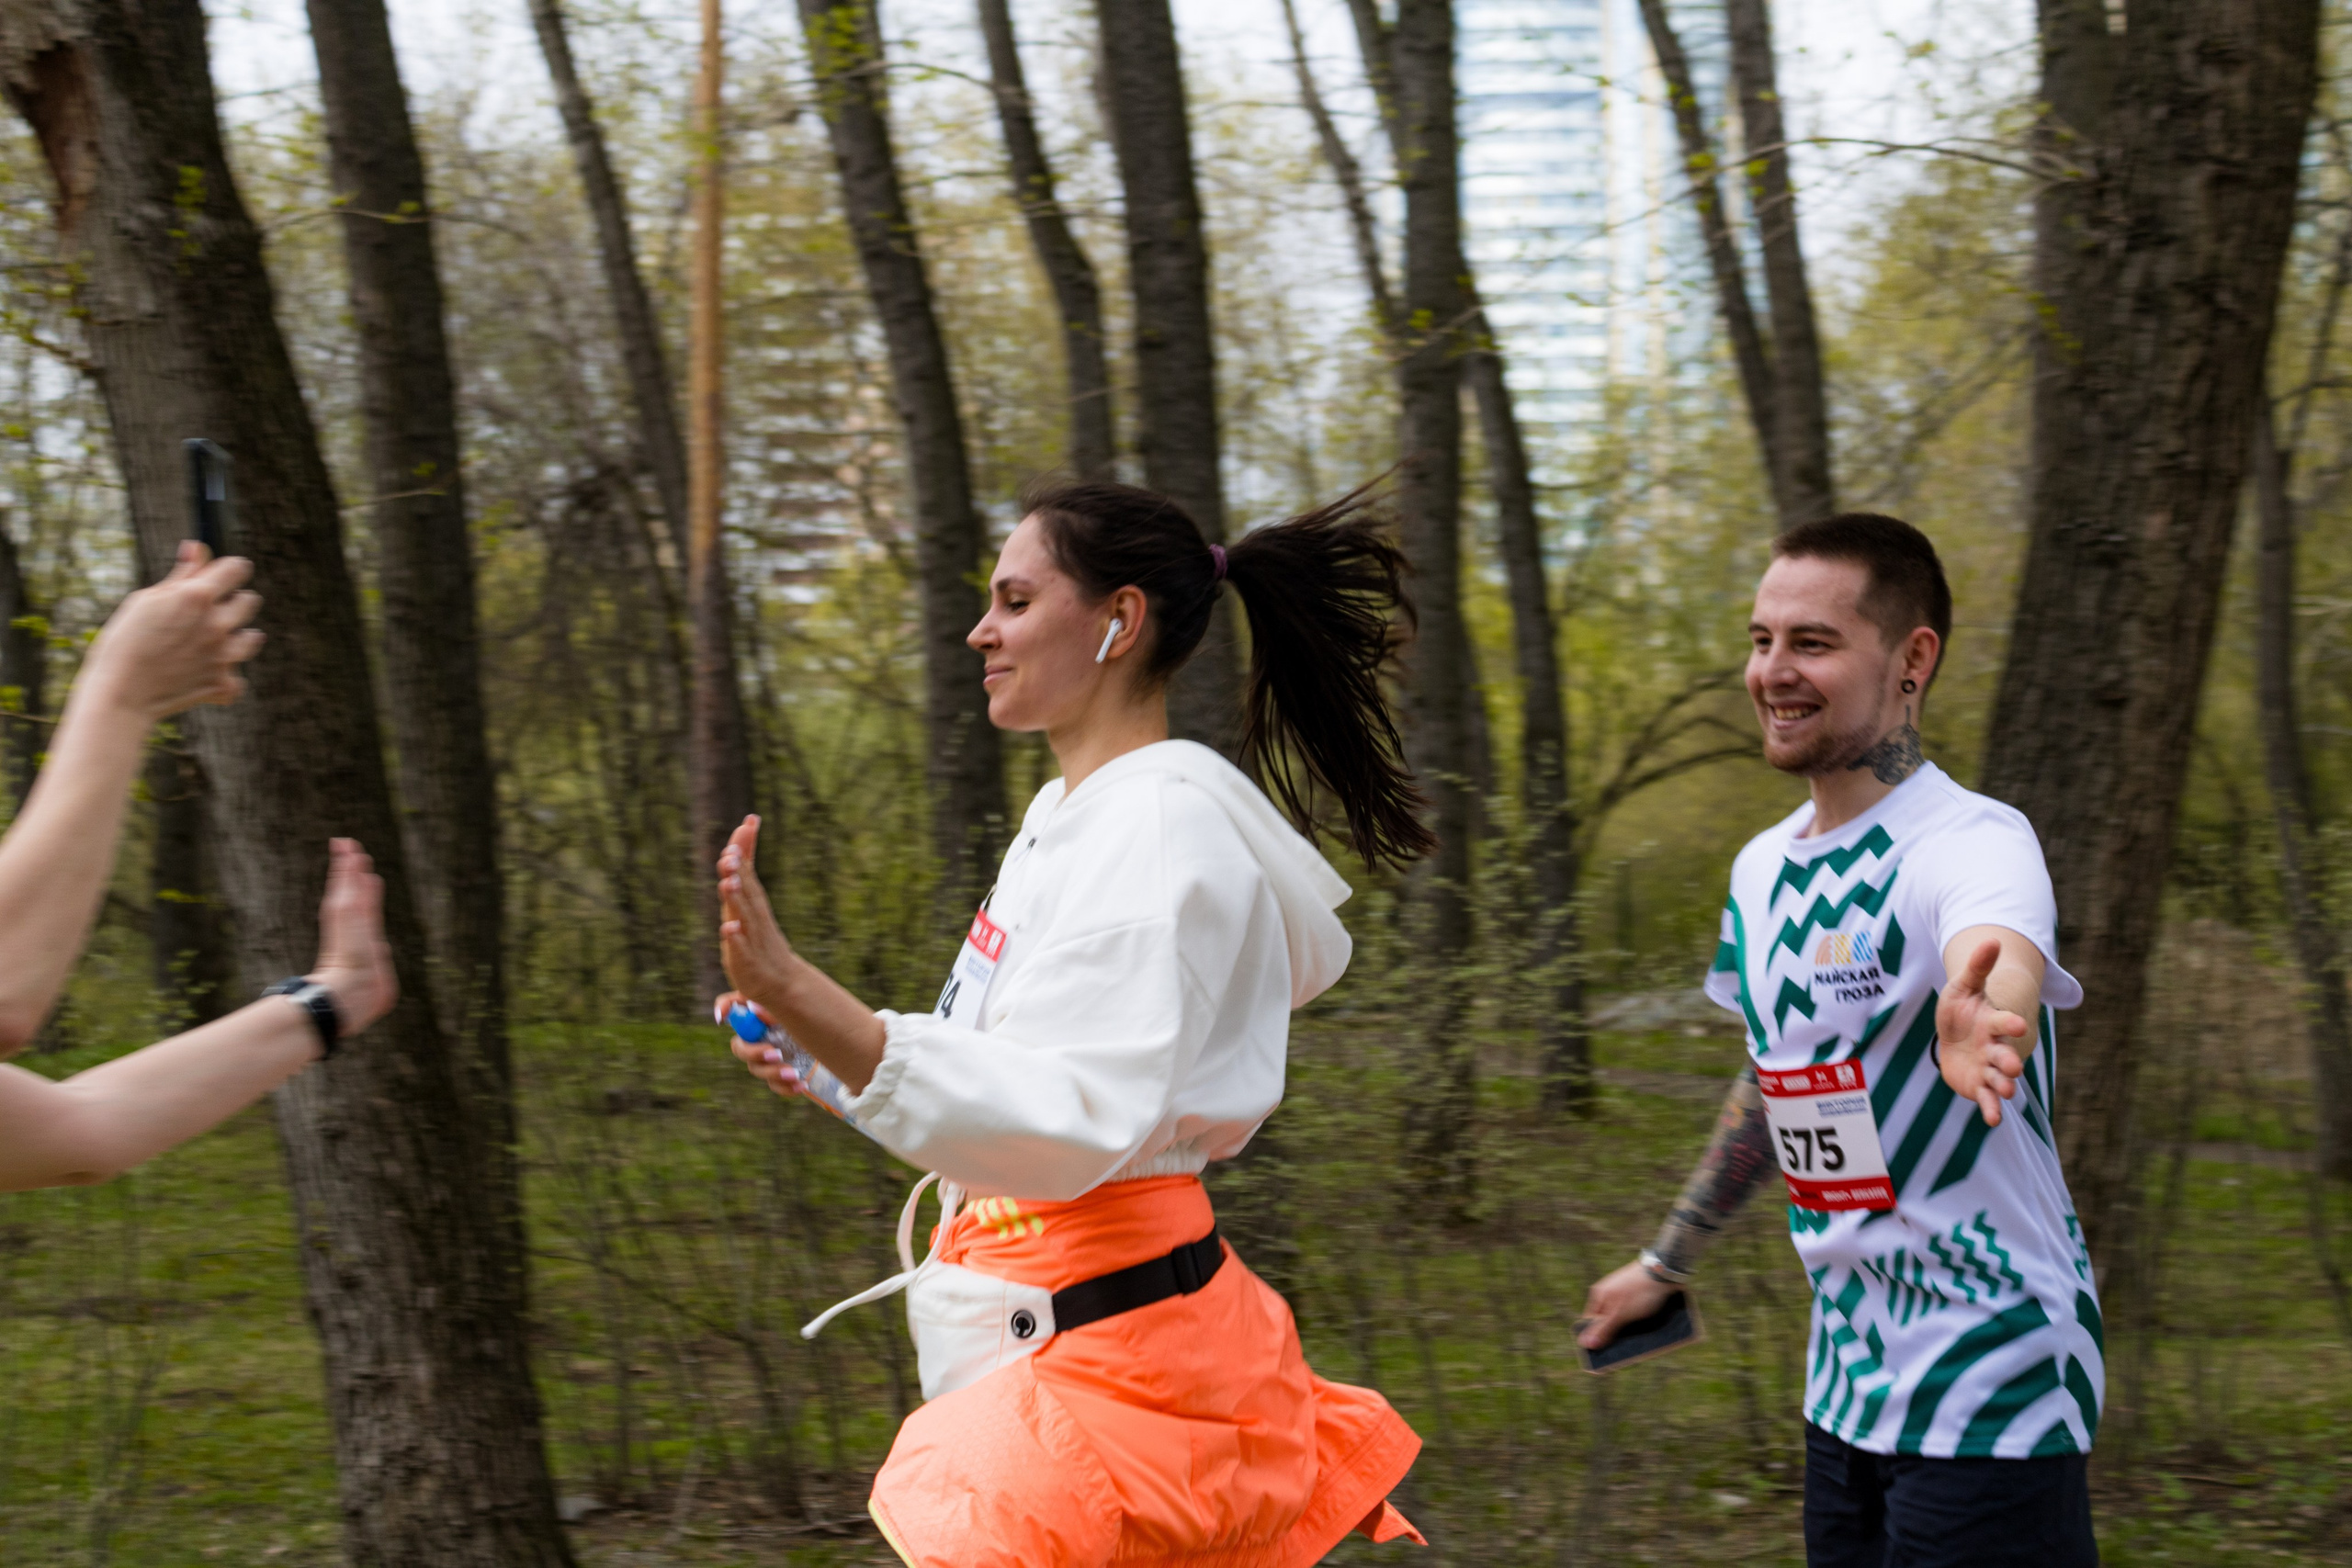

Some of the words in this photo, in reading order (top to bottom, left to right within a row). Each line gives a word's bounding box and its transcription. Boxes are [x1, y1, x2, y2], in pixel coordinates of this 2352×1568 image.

[1814, 966, 1881, 986] МАЙСКАЯ
[1836, 983, 1885, 1004] ГРОЗА
[1778, 1125, 1845, 1172] 575
